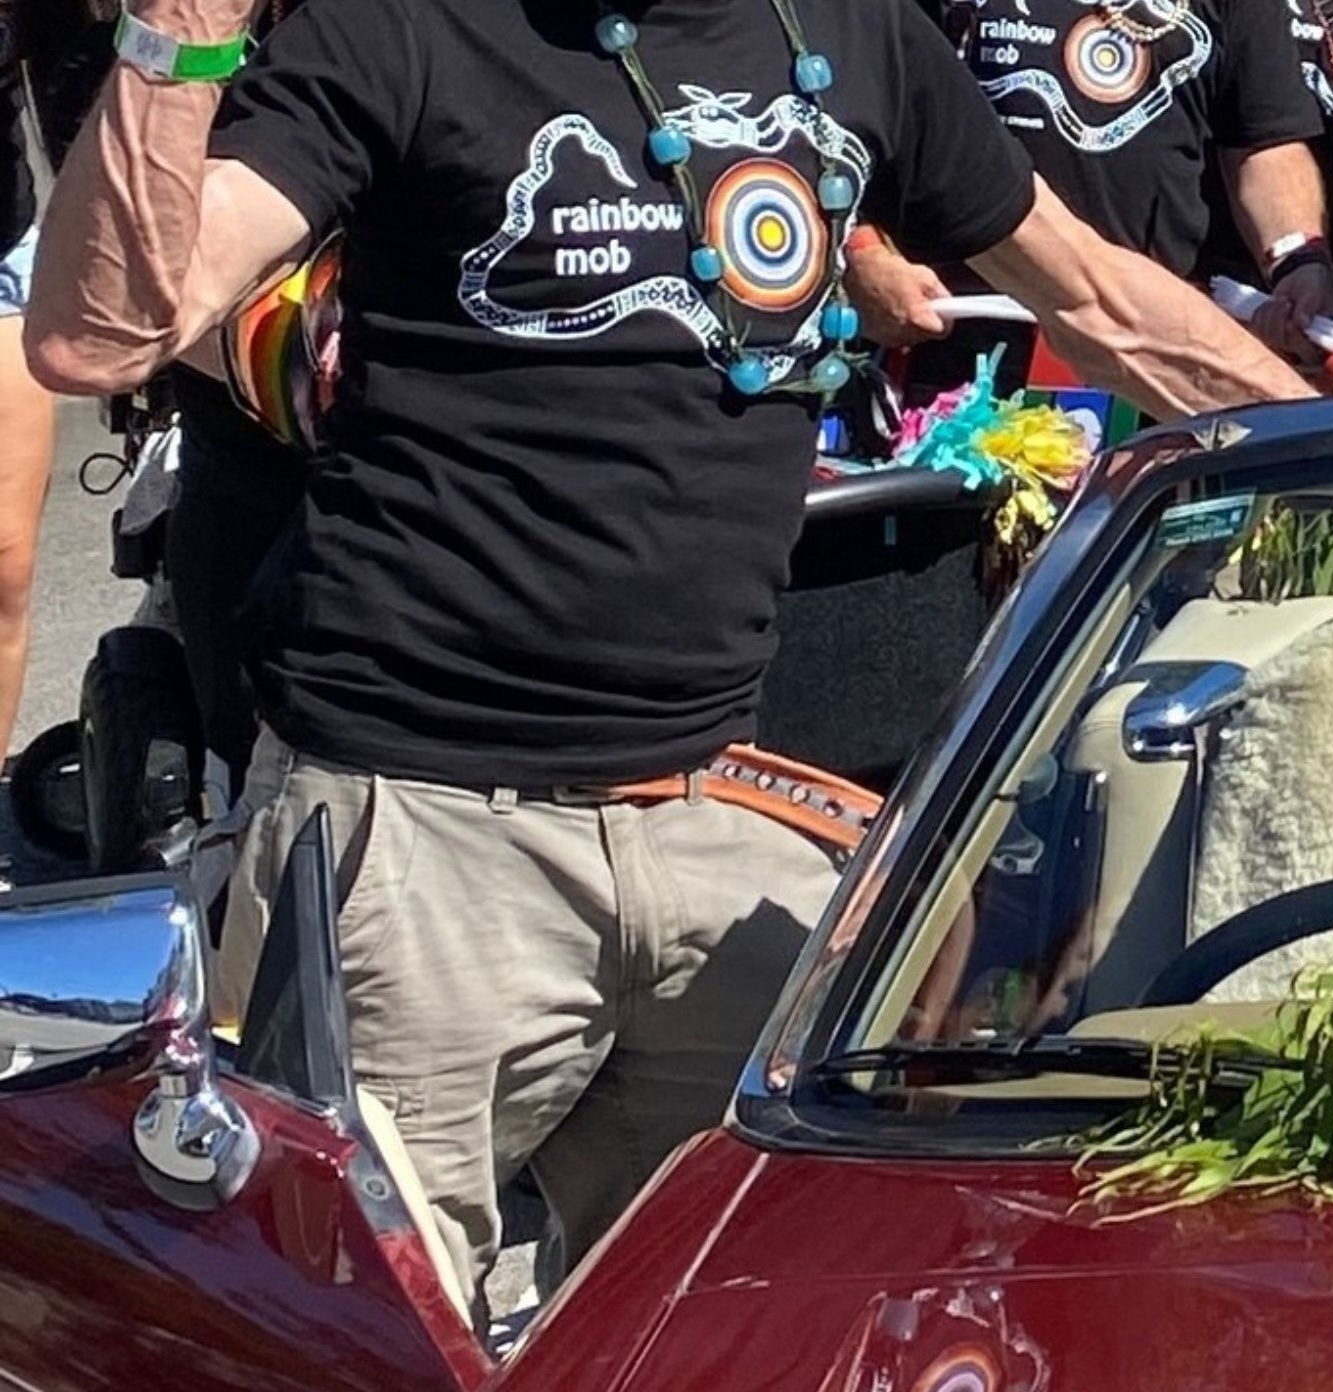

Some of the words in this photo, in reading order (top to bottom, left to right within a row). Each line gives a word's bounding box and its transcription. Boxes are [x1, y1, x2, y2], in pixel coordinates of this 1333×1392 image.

[980, 17, 1057, 44] rainbow
[552, 197, 684, 234] rainbow
[555, 239, 631, 276] mob
